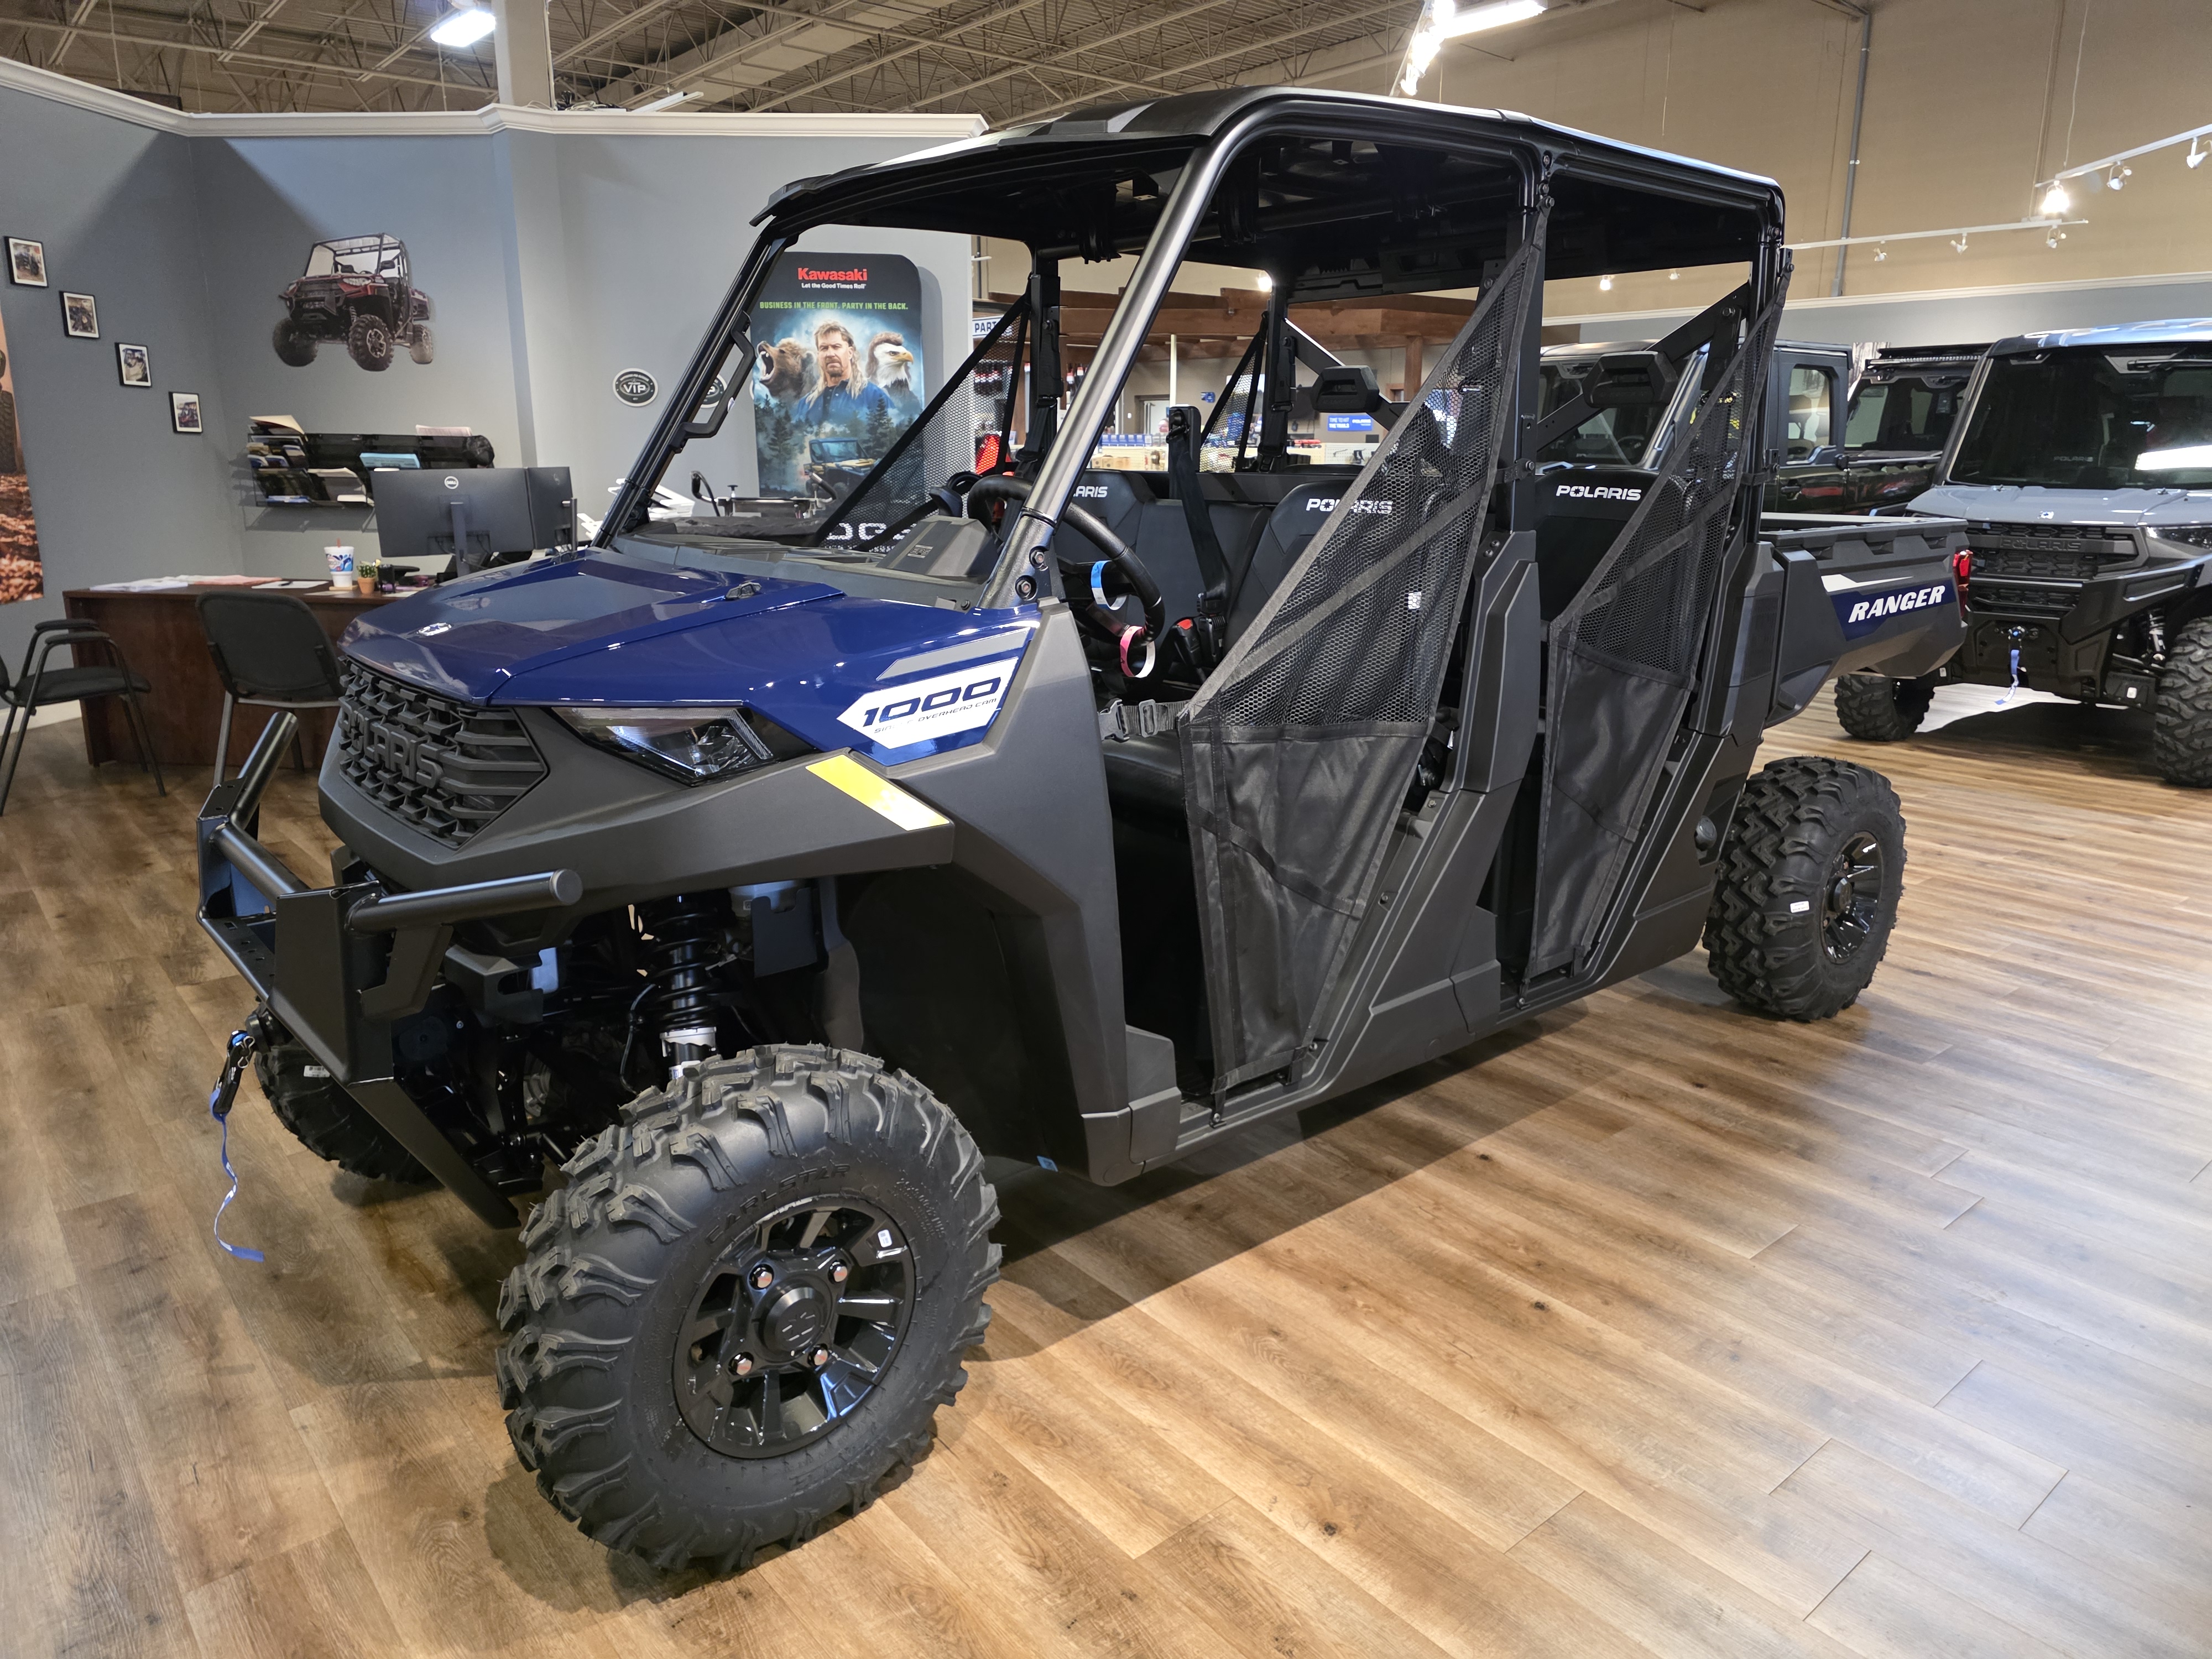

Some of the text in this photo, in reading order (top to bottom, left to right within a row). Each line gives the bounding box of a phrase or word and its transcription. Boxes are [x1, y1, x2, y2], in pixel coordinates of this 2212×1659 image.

[798, 268, 867, 281] Kawasaki
[975, 321, 997, 333] PART
[623, 384, 646, 393] VIP
[1073, 486, 1108, 498] ARIS
[1556, 485, 1642, 501] POLARIS
[2000, 539, 2081, 551] POLARIS
[1848, 585, 1945, 623] RANGER
[863, 676, 1001, 727] 1000
[918, 705, 973, 722] OVERHEAD
[975, 698, 997, 707] CAM
[338, 698, 444, 789] POLARIS
[705, 1162, 852, 1245] CARLSTAR
